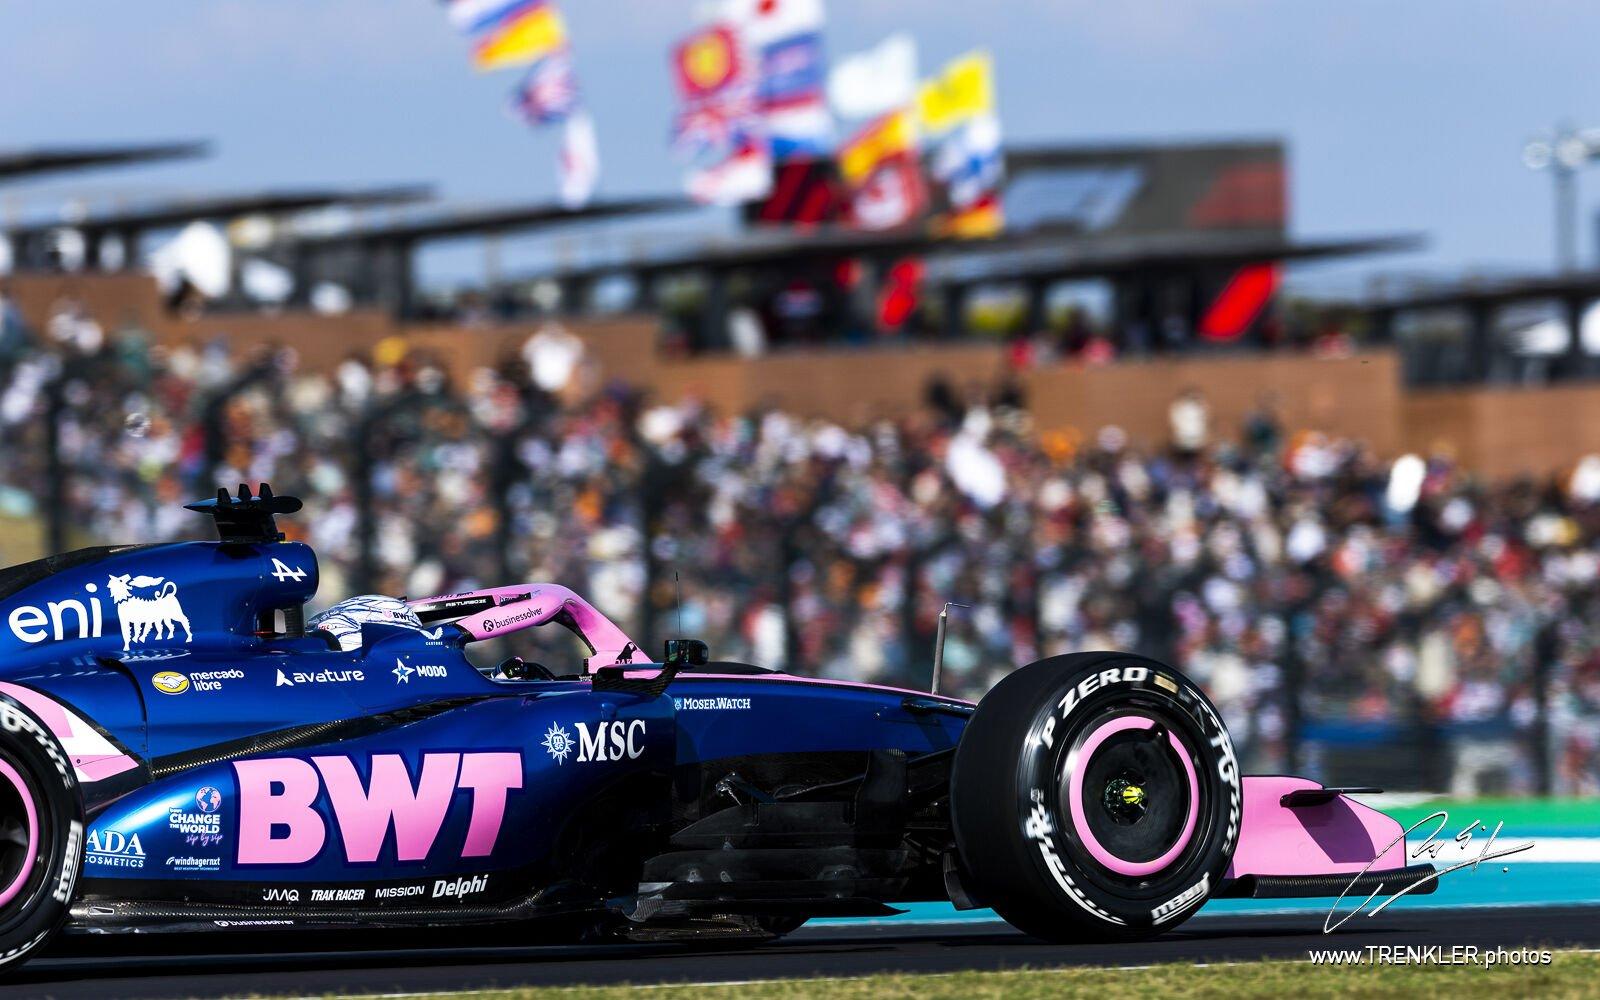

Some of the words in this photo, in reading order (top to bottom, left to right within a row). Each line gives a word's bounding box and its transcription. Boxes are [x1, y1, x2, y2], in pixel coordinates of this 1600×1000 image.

[8, 583, 102, 643] eni
[495, 607, 543, 628] businessolver
[189, 668, 244, 681] mercado
[292, 669, 365, 683] avature
[415, 665, 448, 678] MODO
[192, 680, 222, 692] libre
[1058, 667, 1149, 719] ZERO
[574, 719, 646, 763] MSC
[232, 752, 523, 864] BWT
[169, 813, 221, 825] CHANGE
[180, 824, 220, 834] WORLD
[174, 856, 220, 867] windhagernxt
[375, 885, 425, 898] MISSION
[432, 874, 488, 899] Delphi
[311, 890, 336, 900] TRAK
[336, 889, 365, 900] RACER
